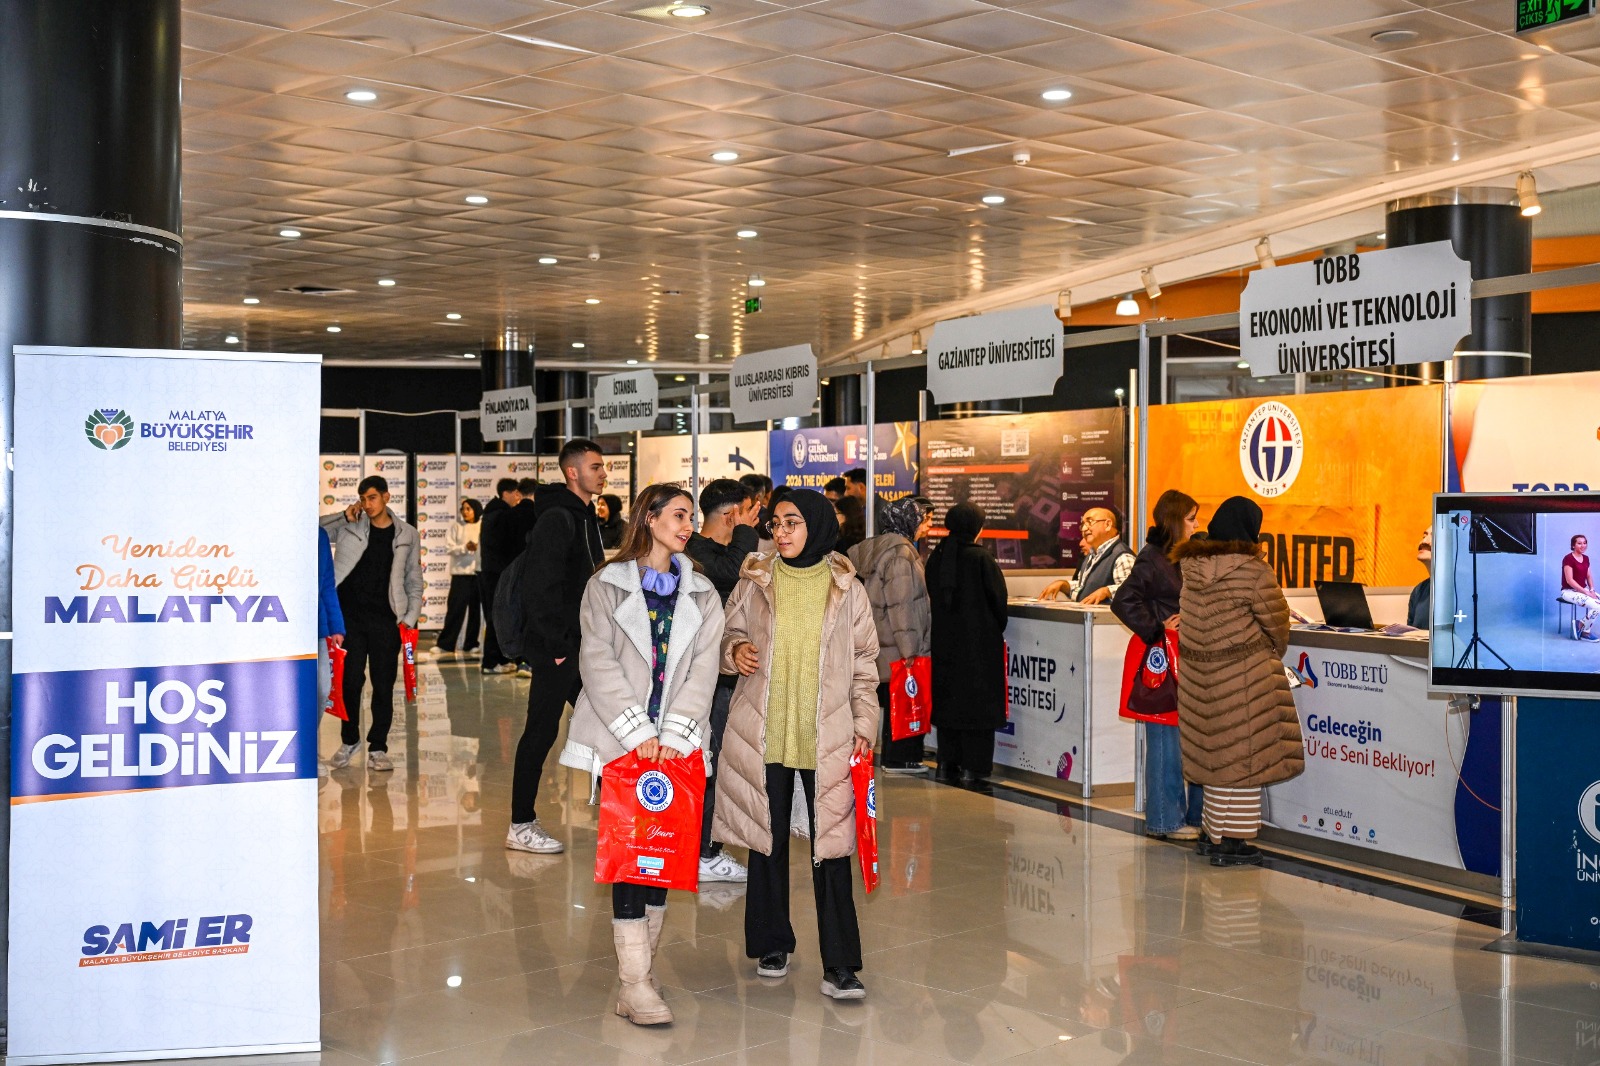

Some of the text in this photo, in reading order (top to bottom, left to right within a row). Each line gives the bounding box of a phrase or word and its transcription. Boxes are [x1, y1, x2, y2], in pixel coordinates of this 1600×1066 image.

[1520, 0, 1542, 14] EXIT
[1520, 11, 1544, 29] ÇIKIŞ
[1313, 254, 1360, 285] TOBB
[1250, 282, 1456, 337] EKONOMİ VE TEKNOLOJİ
[938, 333, 1055, 370] GAZİANTEP ÜNİVERSİTESİ
[1278, 332, 1395, 374] ÜNİVERSİTESİ
[613, 379, 637, 395] İSTANBUL
[734, 364, 809, 388] ULUSLARARASI KIBRIS
[749, 384, 794, 402] ÜNİVERSİTESİ
[169, 410, 227, 421] MALATYA
[496, 416, 517, 432] EĞİTİM
[141, 423, 254, 441] BÜYÜKŞEHİR
[803, 474, 815, 486] THE
[101, 534, 234, 561] Yeniden
[76, 564, 259, 594] Daha Güçlü
[44, 596, 289, 623] MALATYA
[1322, 661, 1388, 684] TOBB ETÜ
[105, 679, 227, 728] HOŞ
[1307, 714, 1382, 744] Geleceğin
[31, 730, 298, 780] GELDİNİZ
[1340, 745, 1368, 765] Seni
[1373, 750, 1435, 778] Bekliyor!
[1324, 806, 1352, 819] etu.edu.tr
[81, 914, 253, 955] SAMİ ER
